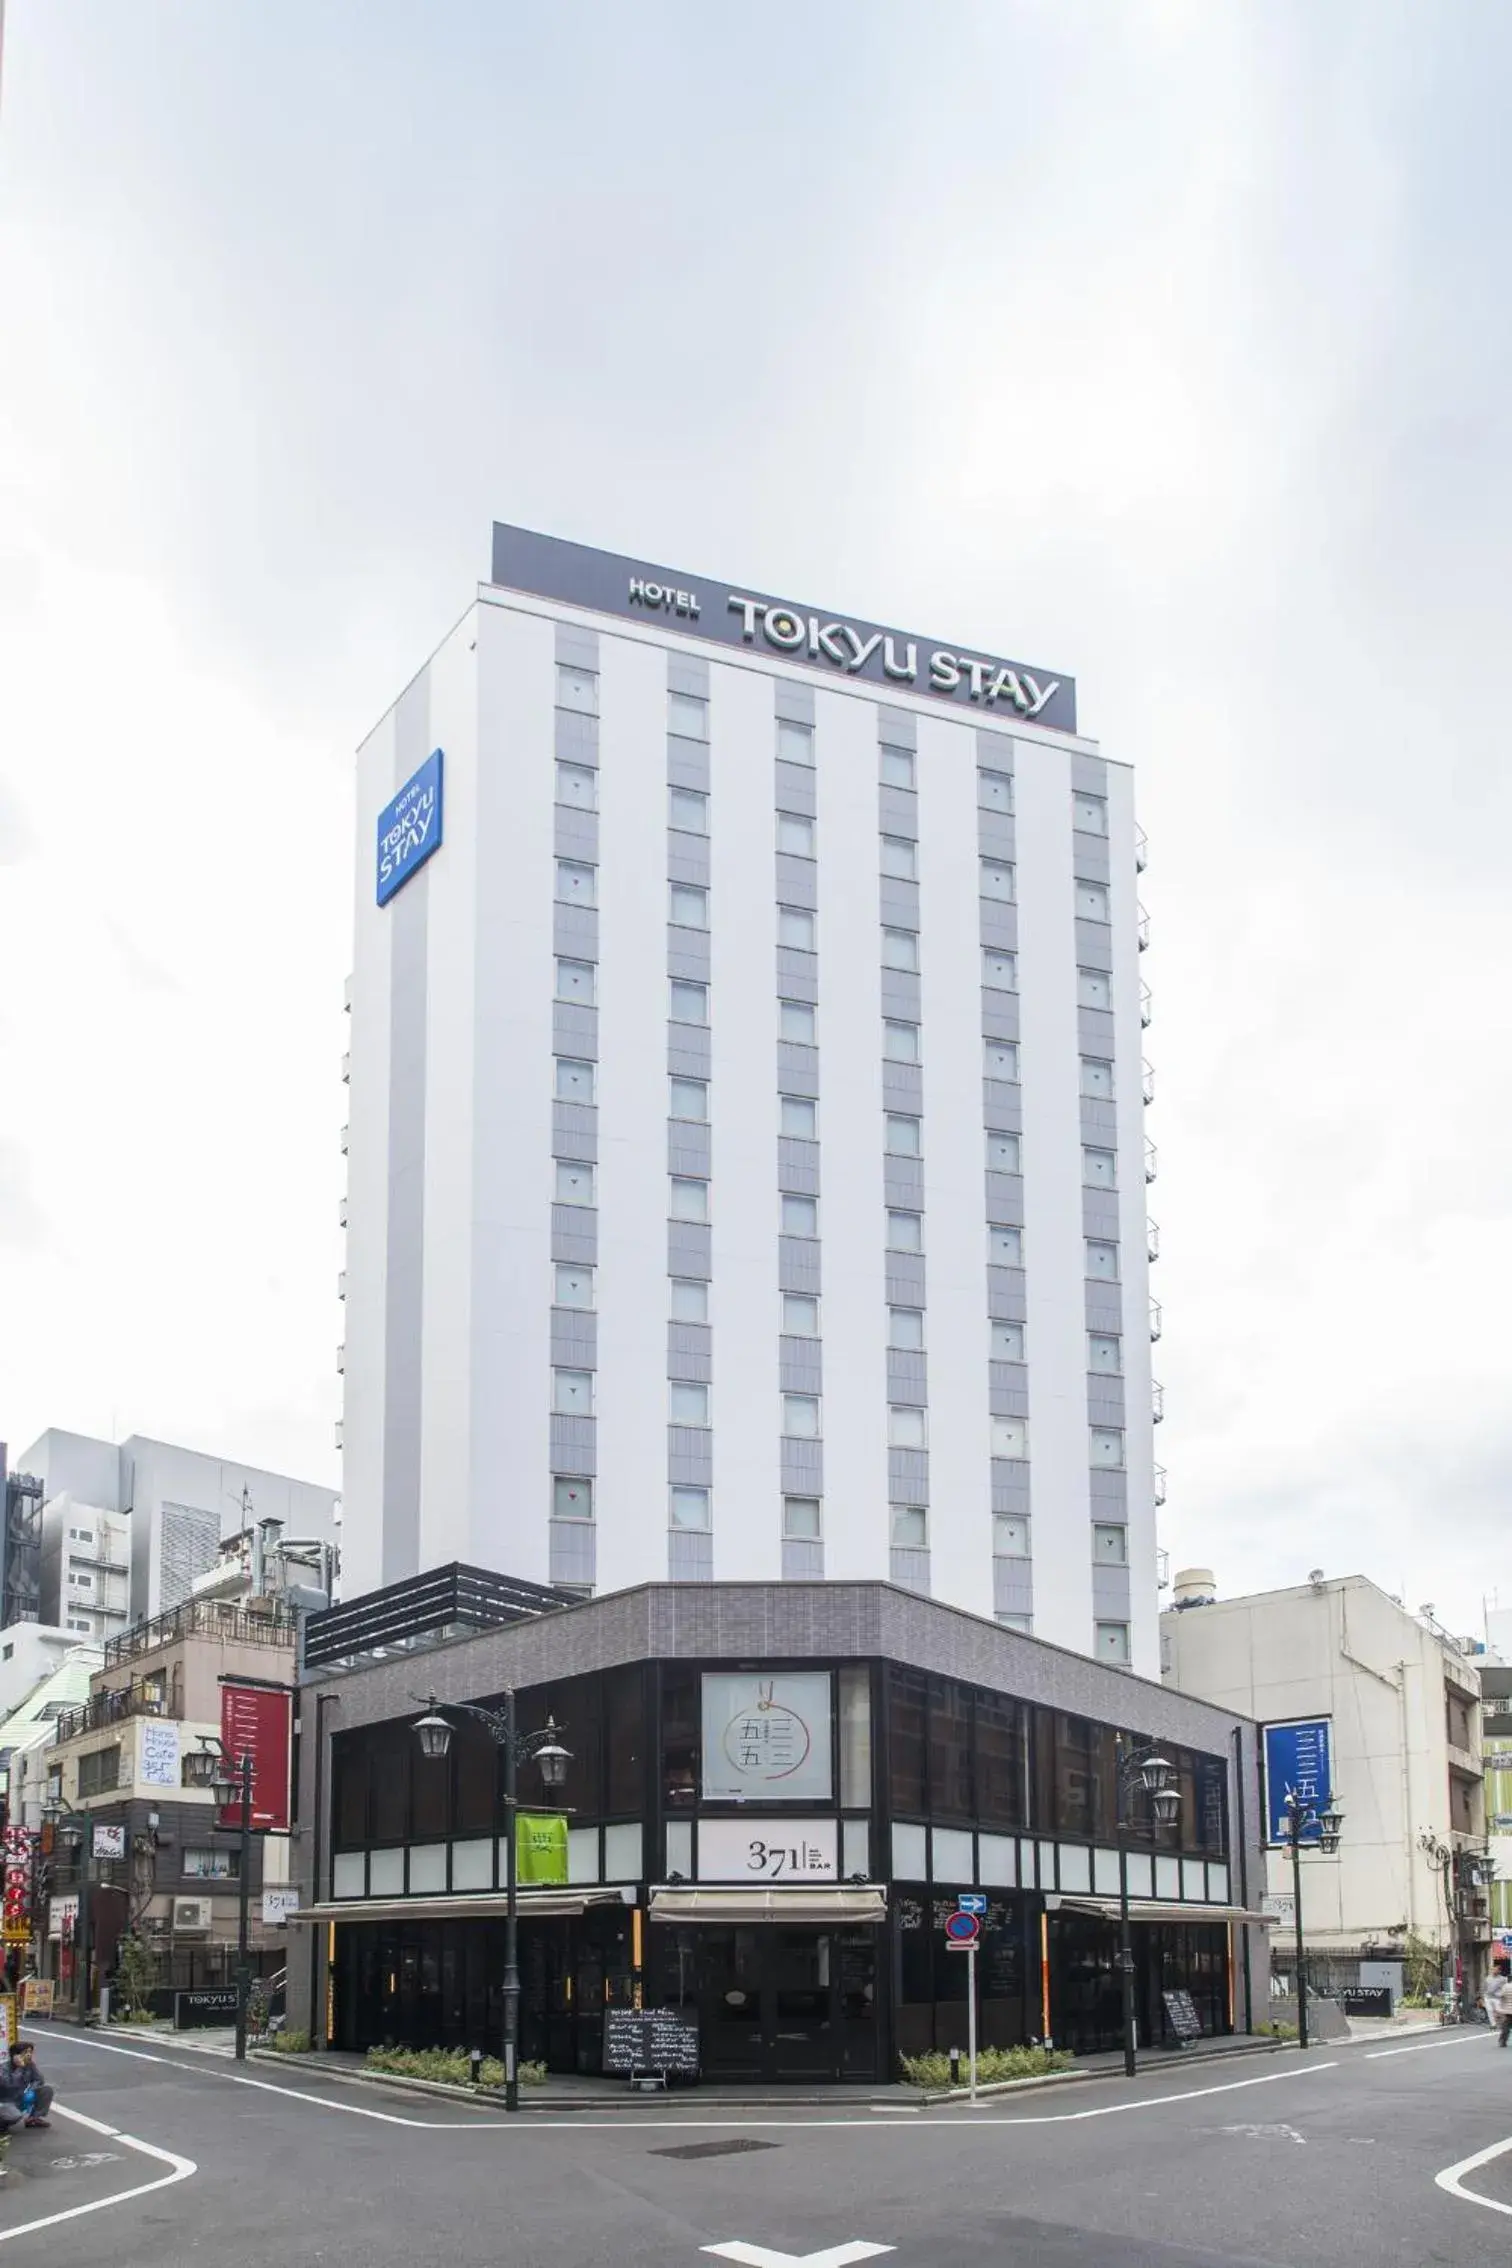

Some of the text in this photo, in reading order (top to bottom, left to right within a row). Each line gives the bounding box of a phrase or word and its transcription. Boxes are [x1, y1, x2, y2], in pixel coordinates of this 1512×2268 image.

[629, 576, 1060, 717] HOTEL TOKYU STAY
[380, 786, 434, 853] TOKYU
[395, 784, 420, 817] HOTEL
[380, 807, 434, 883] STAY
[746, 1840, 800, 1878] 371
[188, 1994, 227, 2004] TOKYU
[1357, 1989, 1384, 1998] STAY
